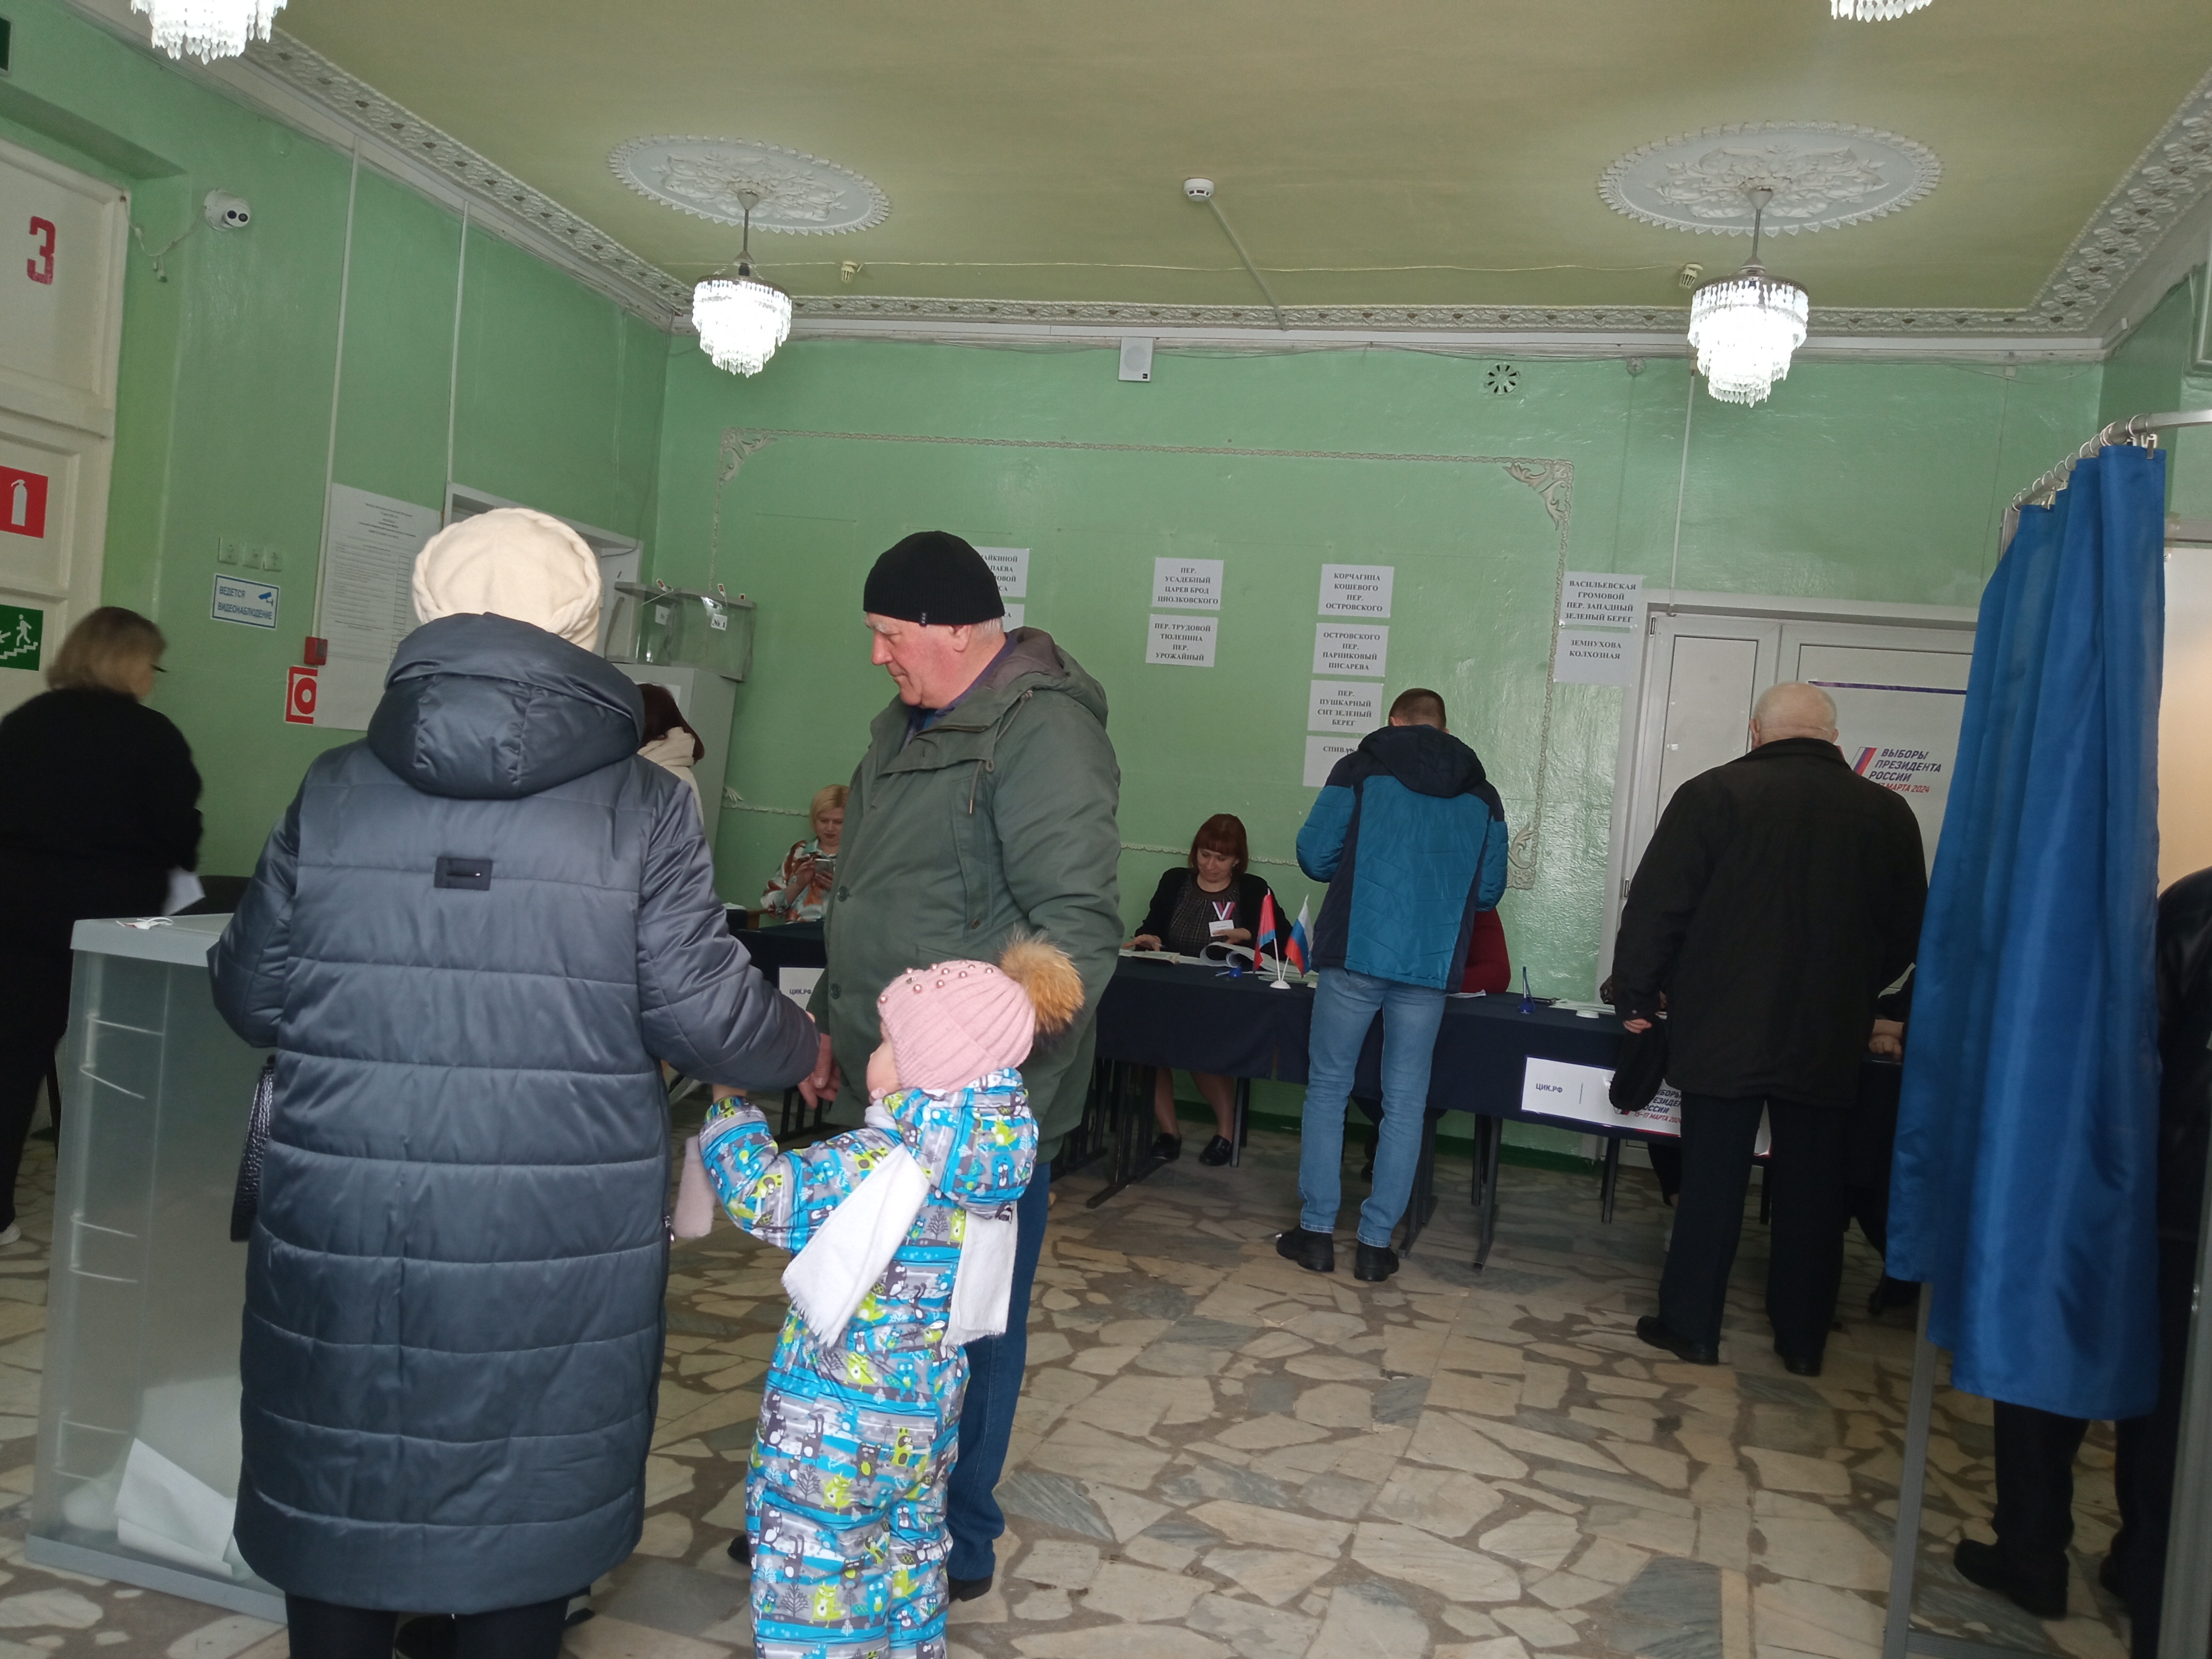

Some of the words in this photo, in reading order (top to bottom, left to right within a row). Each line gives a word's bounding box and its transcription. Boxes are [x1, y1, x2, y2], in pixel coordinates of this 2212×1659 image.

[27, 216, 56, 284] 3
[1165, 576, 1211, 584] УСАДЕБНЫЙ
[1570, 580, 1636, 590] ВАСИЛЬЕВСКАЯ
[220, 586, 245, 598] ВЕДЕТСЯ
[1158, 596, 1218, 605] ЦИОЛКОВСКОГО
[218, 602, 272, 619] ВИДЕОНАБЛЮДЕНИЕ
[1326, 603, 1382, 611] ОСТРОВСКОГО
[1587, 603, 1633, 611] ЗАПАДНЫЙ
[1571, 640, 1621, 648] ЗЕМНУХОВА
[1323, 652, 1377, 660] ПАРНИКОВЫЙ
[1570, 650, 1620, 659] КОЛХОЗНАЯ
[1881, 749, 1929, 759] ВЫБОРЫ
[1875, 760, 1941, 772] ПРЕЗИДЕНТА
[1869, 771, 1912, 782] РОССИИ
[1887, 783, 1909, 792] МАРТА
[1536, 1083, 1563, 1093] ЦИК.РФ
[1653, 1097, 1681, 1106] ЕЗИДЕ
